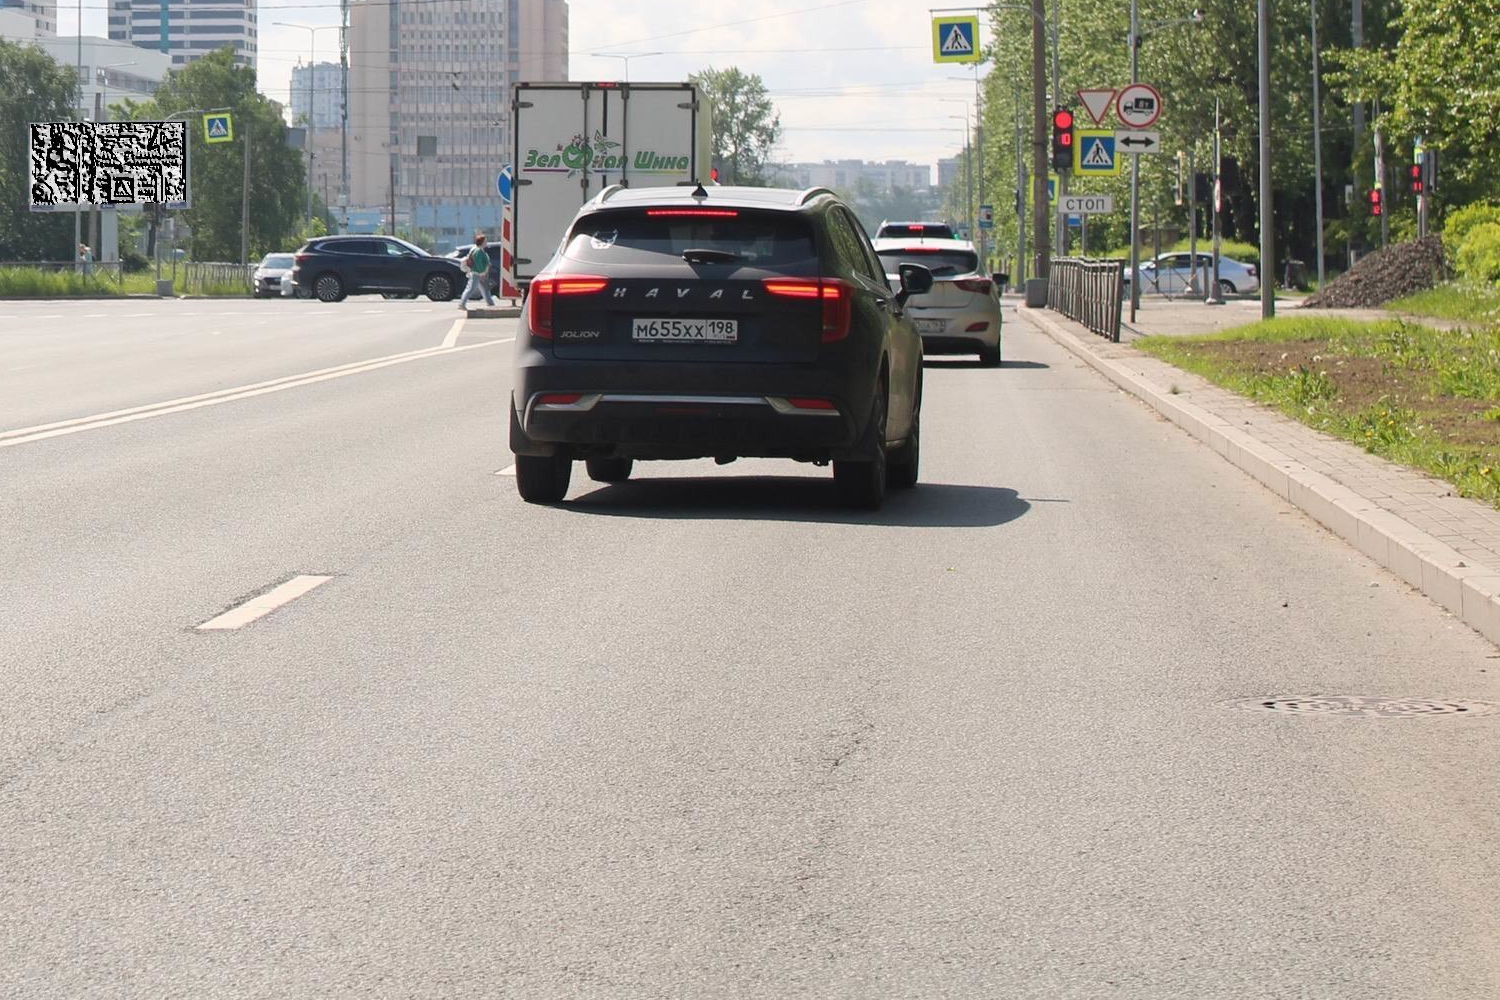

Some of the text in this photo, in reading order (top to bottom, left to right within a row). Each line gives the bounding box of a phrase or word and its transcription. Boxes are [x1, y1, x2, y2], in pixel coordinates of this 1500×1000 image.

[1066, 198, 1105, 211] СТОП
[613, 287, 754, 300] HAVAL
[560, 330, 600, 338] JOLION
[708, 321, 733, 334] 198
